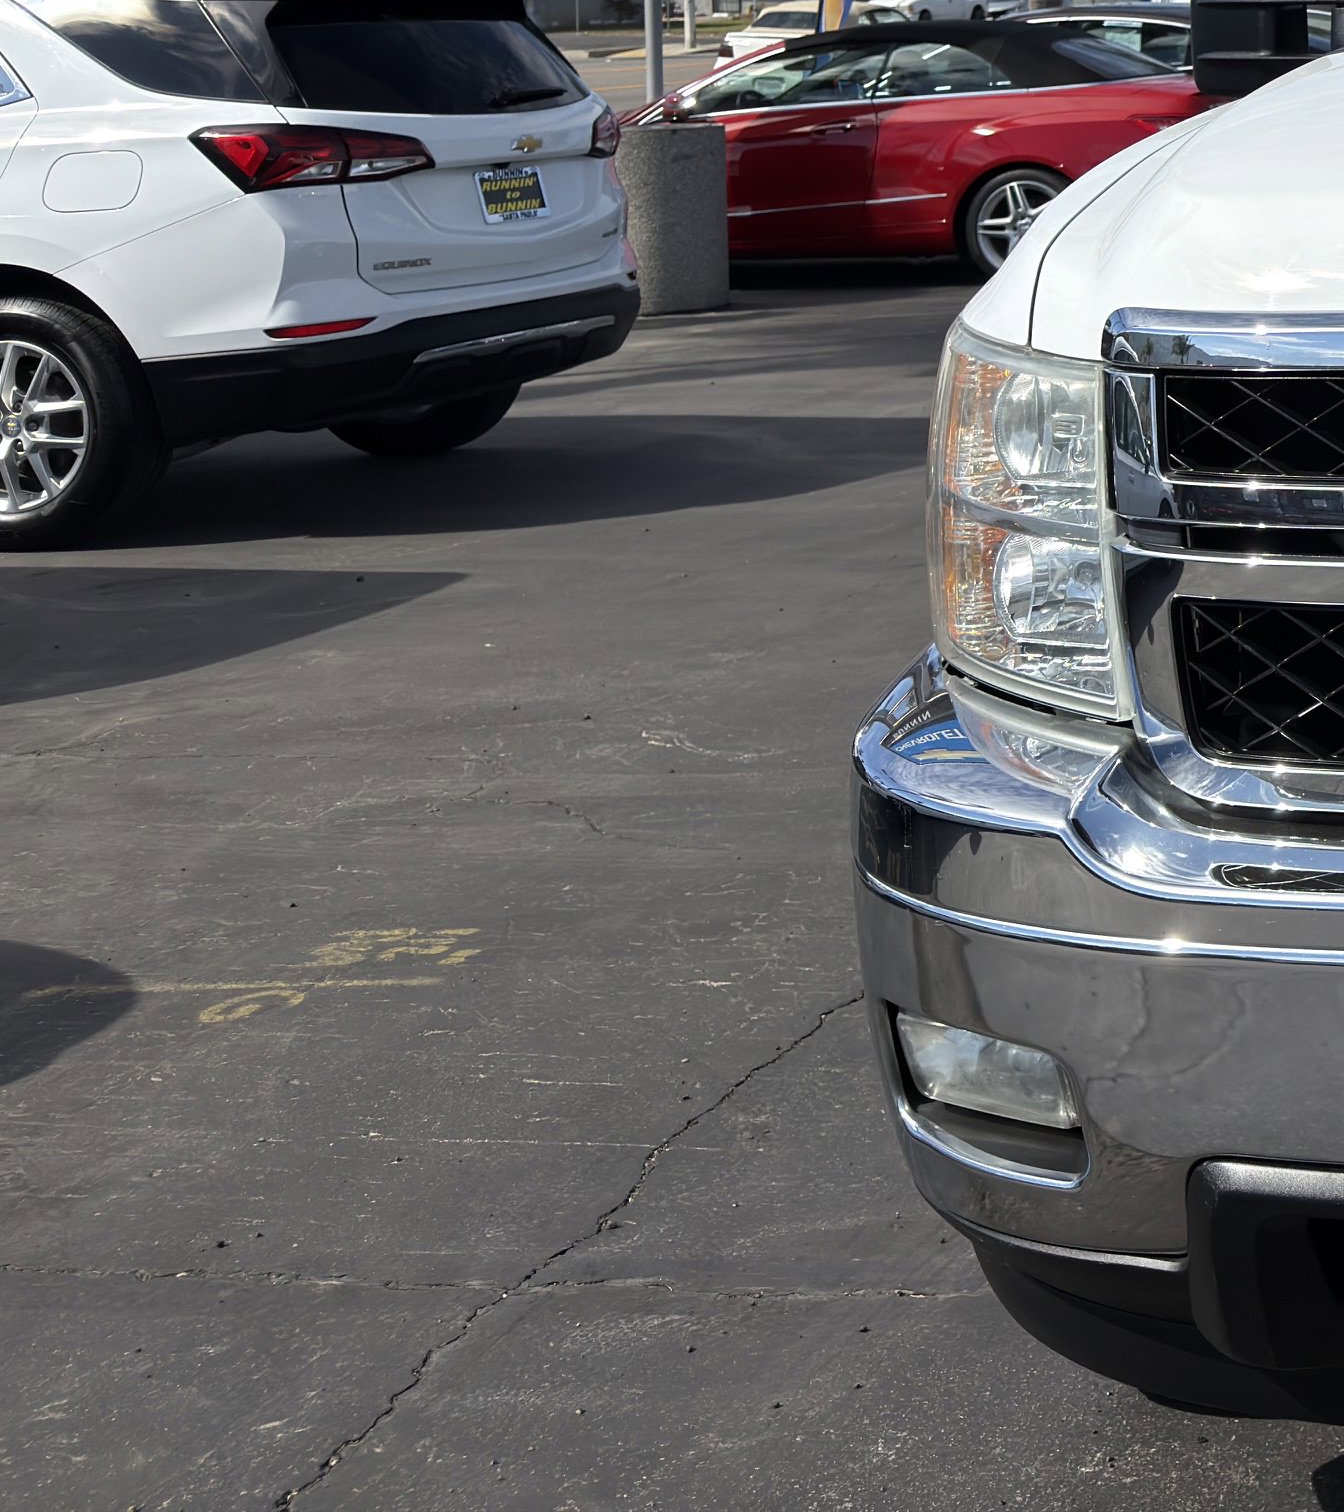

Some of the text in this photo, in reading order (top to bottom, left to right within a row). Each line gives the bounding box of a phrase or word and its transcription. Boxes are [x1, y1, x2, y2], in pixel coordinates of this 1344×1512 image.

[482, 176, 537, 192] RUNNIN'
[506, 190, 521, 200] to
[487, 199, 540, 215] BUNNIN
